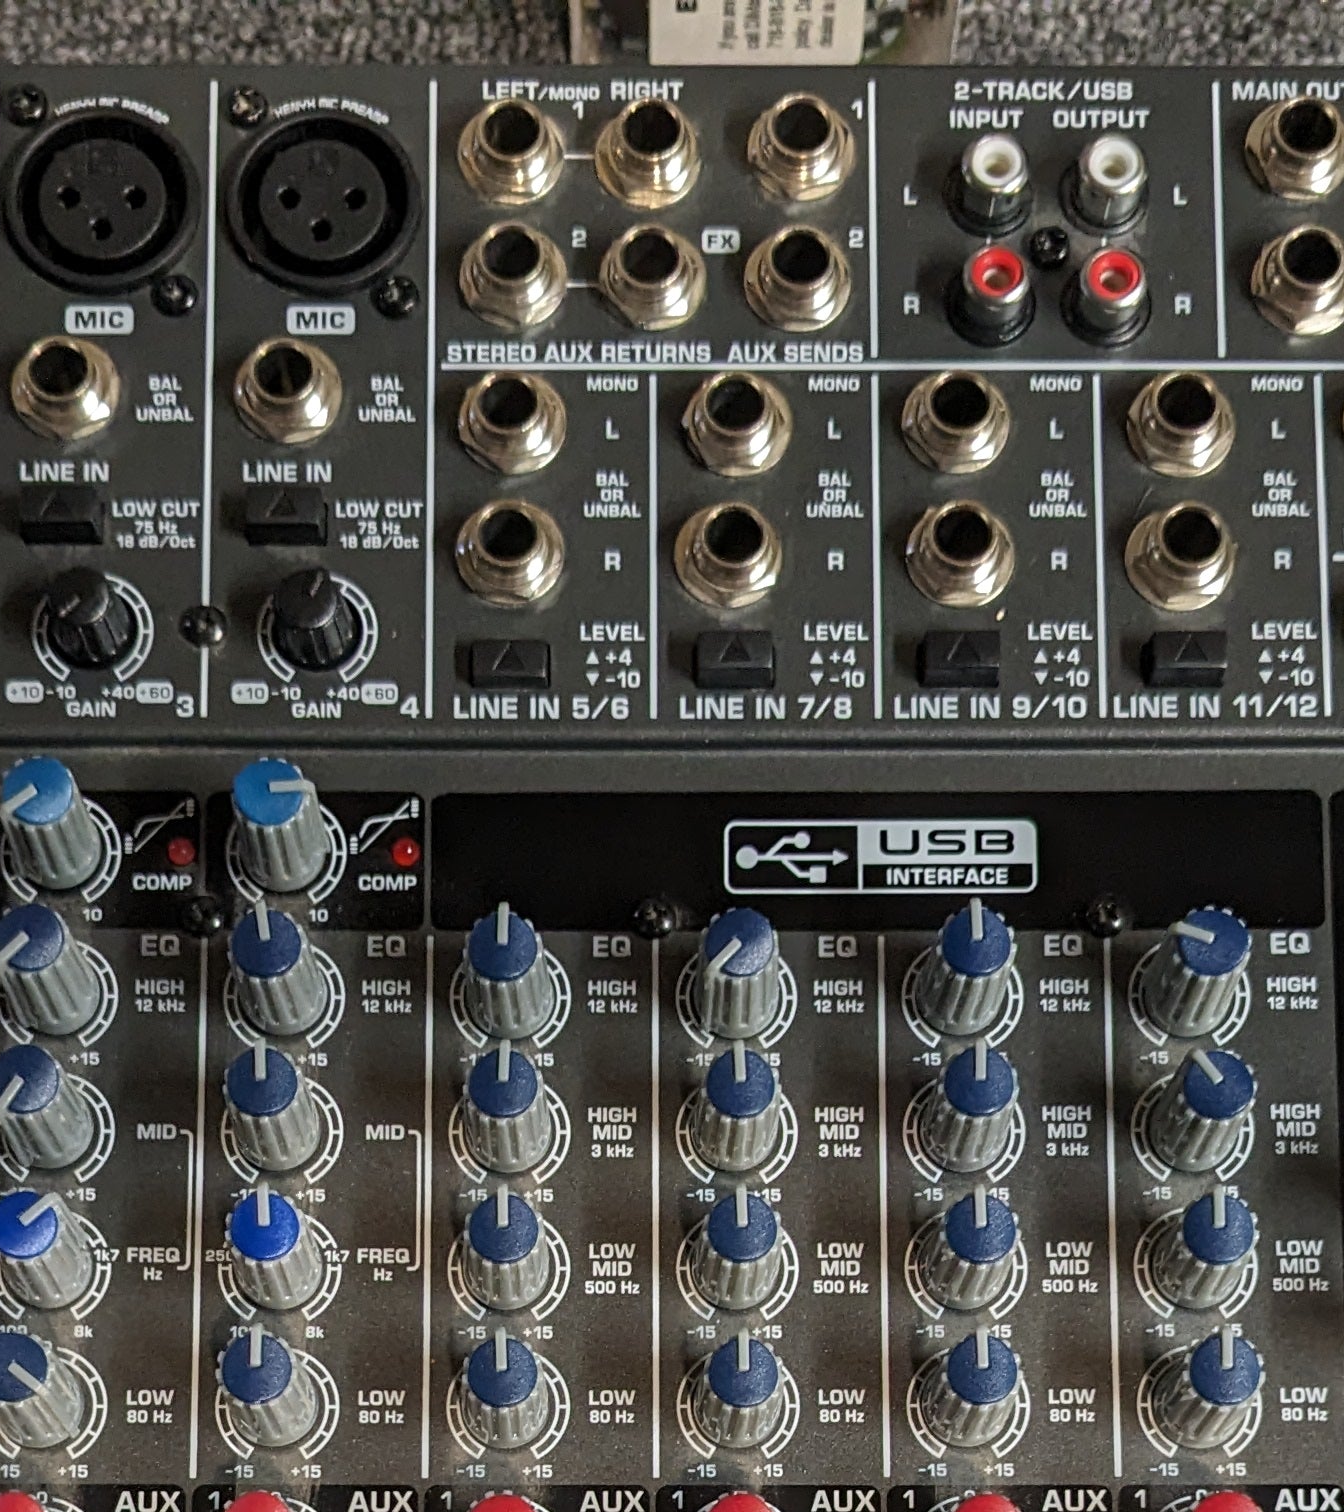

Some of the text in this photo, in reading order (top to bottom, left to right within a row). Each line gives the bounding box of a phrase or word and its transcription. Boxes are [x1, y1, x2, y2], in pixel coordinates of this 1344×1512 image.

[611, 81, 683, 101] RIGHT
[954, 80, 1133, 101] 2-TRACK/USB
[1231, 81, 1300, 100] MAIN
[949, 109, 1150, 129] INPUT OUTPUT
[707, 234, 735, 250] FX
[74, 311, 124, 329] MIC
[296, 311, 345, 329] MIC
[447, 343, 711, 364] STEREO AUX RETURNS
[727, 343, 864, 364] AUX SENDS
[586, 376, 639, 392] MONO
[335, 501, 424, 519] LOW CUT
[580, 623, 646, 642] LEVEL
[291, 701, 342, 719] GAIN
[453, 695, 629, 720] LINE IN 5/6
[894, 695, 1087, 719] LINE IN 9/10
[1113, 694, 1317, 719] LINE IN 11/12
[879, 829, 1015, 856] USB
[886, 867, 1008, 886] INTERFACE
[366, 934, 406, 958] EQ
[587, 979, 637, 996] HIGH
[587, 999, 638, 1014] 12 kHz
[126, 1246, 181, 1264] FREQ
[816, 1242, 864, 1259] LOW
[820, 1259, 861, 1277] MID
[813, 1279, 869, 1294] 500 Hz
